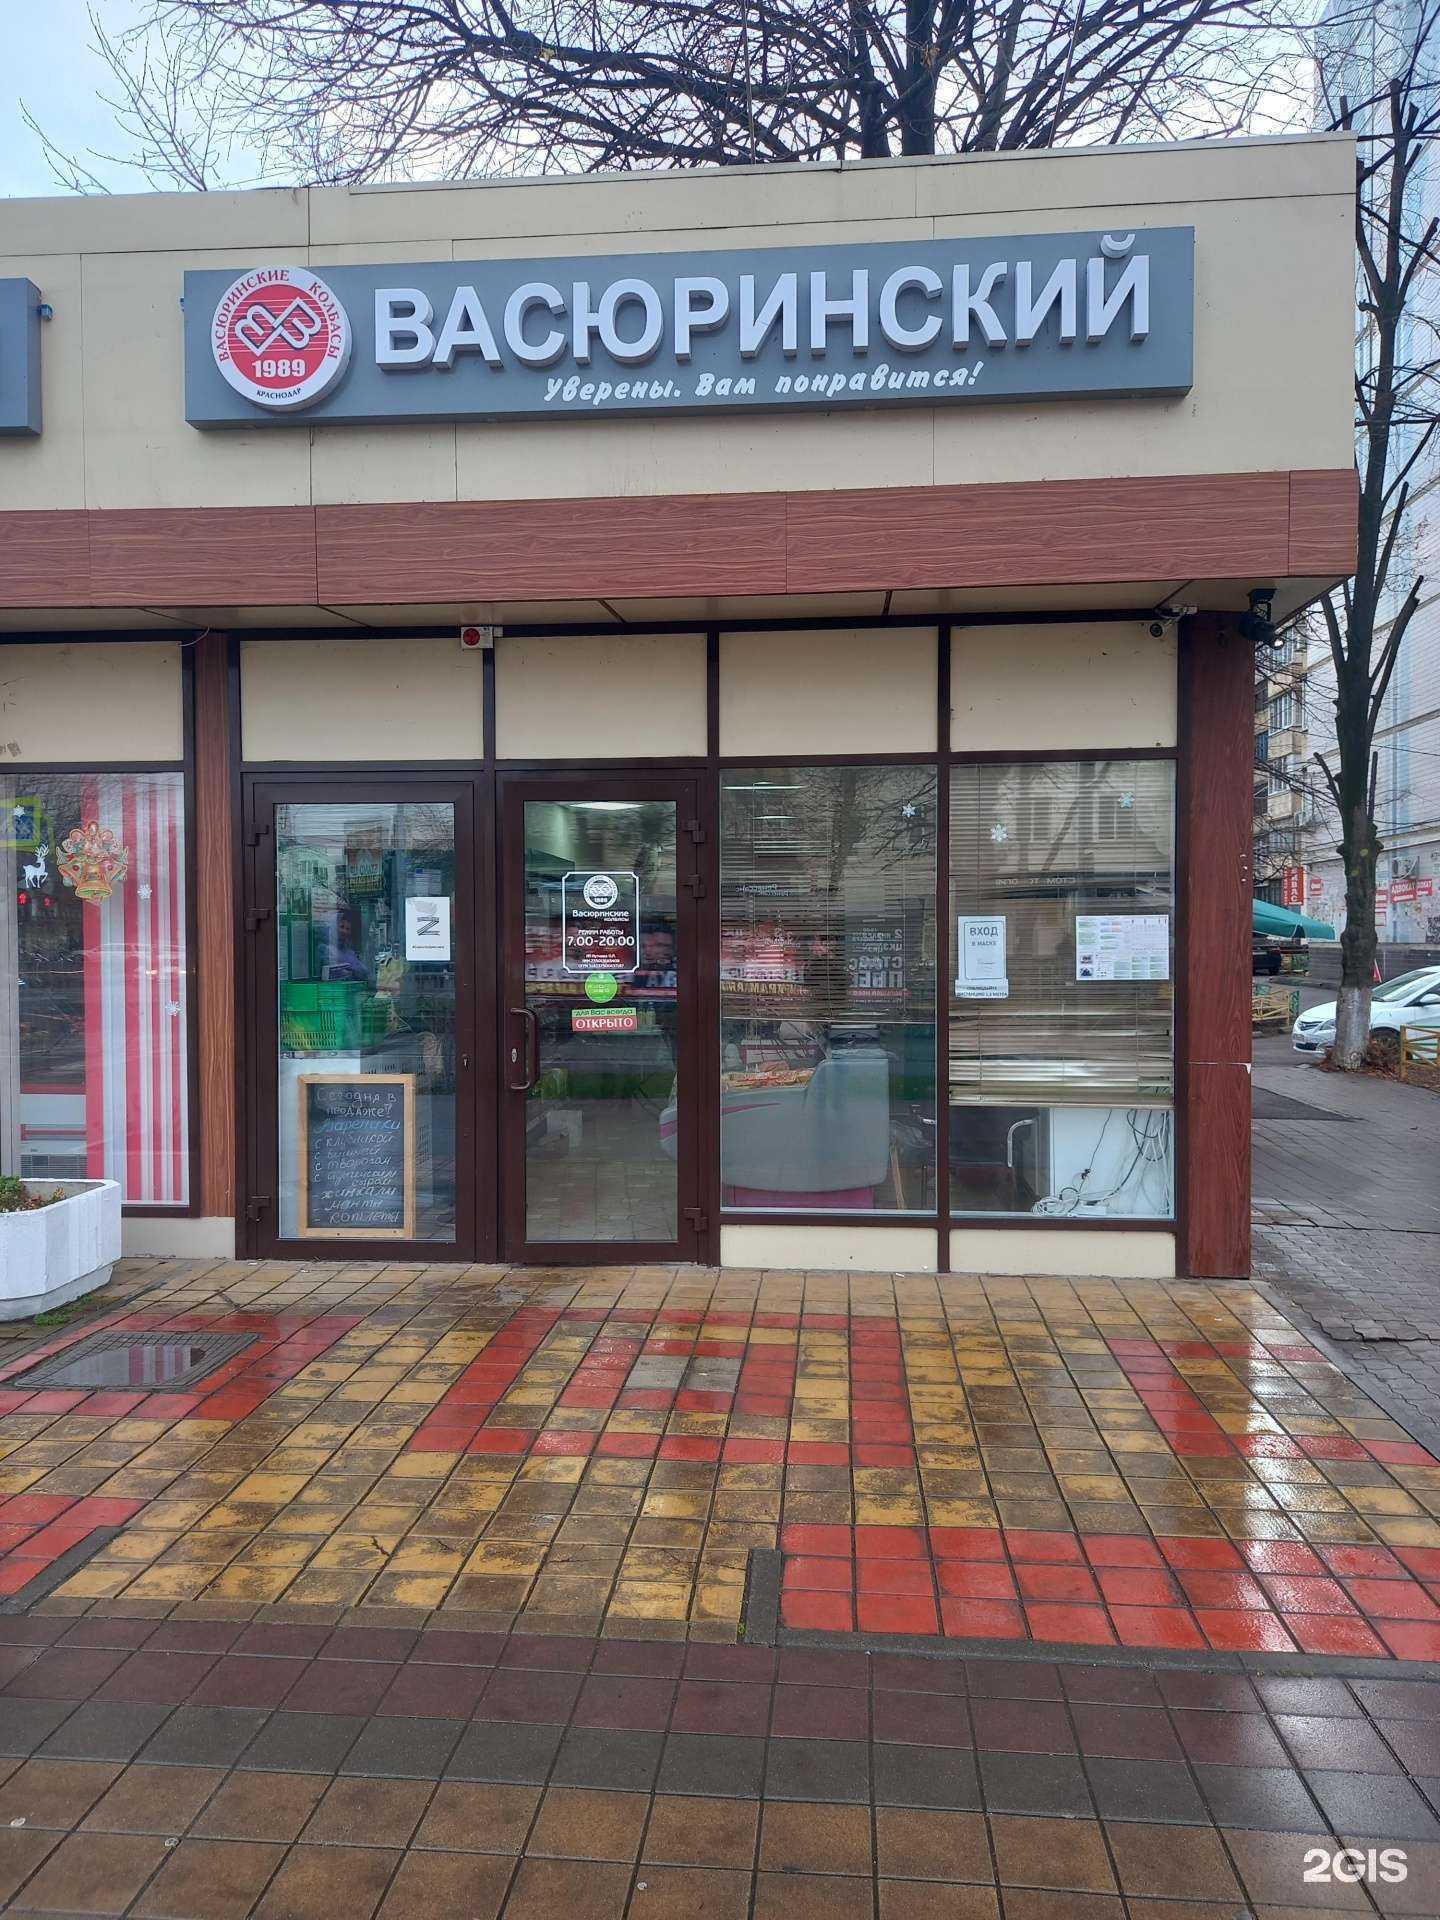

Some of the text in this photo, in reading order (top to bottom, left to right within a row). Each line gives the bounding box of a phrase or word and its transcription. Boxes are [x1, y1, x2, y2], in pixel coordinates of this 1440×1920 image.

[374, 233, 1150, 368] ВАСЮРИНСКИЙ
[217, 268, 344, 363] ВАСЮРИНСКИЕ КОЛБАСЫ
[251, 359, 306, 378] 1989
[695, 373, 757, 396] Вам
[774, 360, 985, 396] понравится!
[256, 387, 302, 401] КРАСНОДАР
[969, 926, 999, 937] ВХОД
[567, 936, 635, 947] 7.00-20.00
[575, 1017, 634, 1029] ОТКРЫТО
